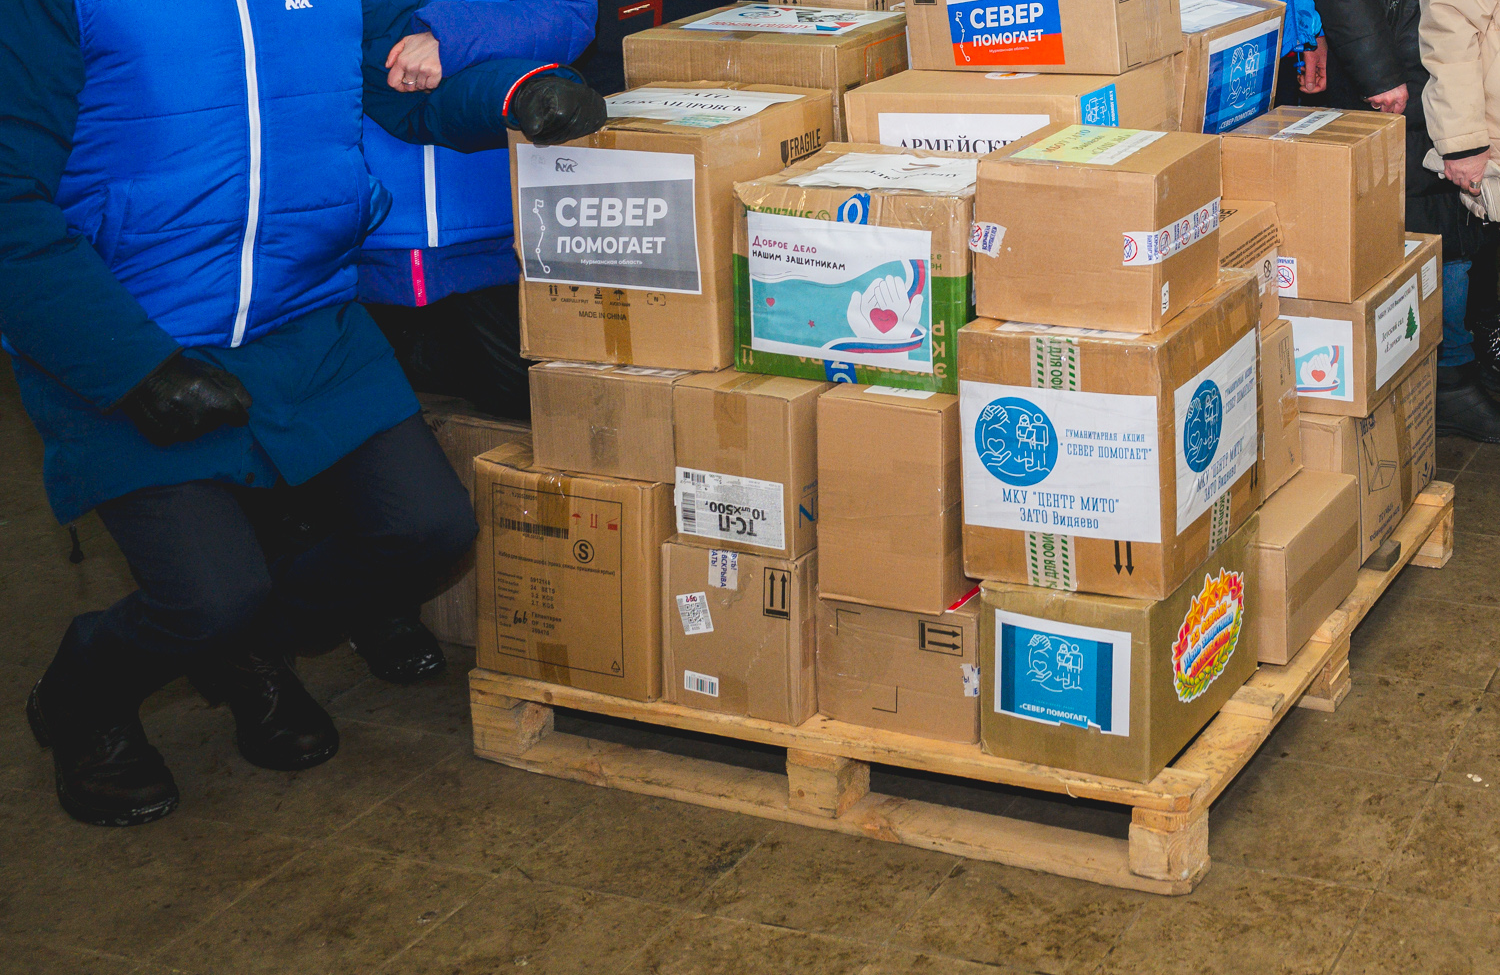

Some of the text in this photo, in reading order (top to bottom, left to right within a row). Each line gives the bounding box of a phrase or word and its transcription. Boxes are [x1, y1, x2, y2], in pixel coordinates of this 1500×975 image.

[970, 2, 1044, 29] СЕВЕР
[972, 29, 1043, 48] ПОМОГАЕТ
[790, 129, 822, 154] FRAGILE
[555, 197, 668, 227] СЕВЕР
[557, 237, 666, 254] ПОМОГАЕТ
[752, 251, 846, 271] НАШИМ ЗАЩИТНИКАМ
[579, 310, 597, 319] MADE
[604, 312, 627, 321] CHINA
[1065, 428, 1146, 443] ГУМАНИТАРНАЯ АКЦИЯ
[1067, 444, 1093, 458] СЕВЕР
[1002, 488, 1120, 514] МКУ "ЦЕНТР МИТО"
[1019, 507, 1099, 530] ЗАТО Видяево
[579, 543, 589, 560] S
[1190, 626, 1200, 650] 23
